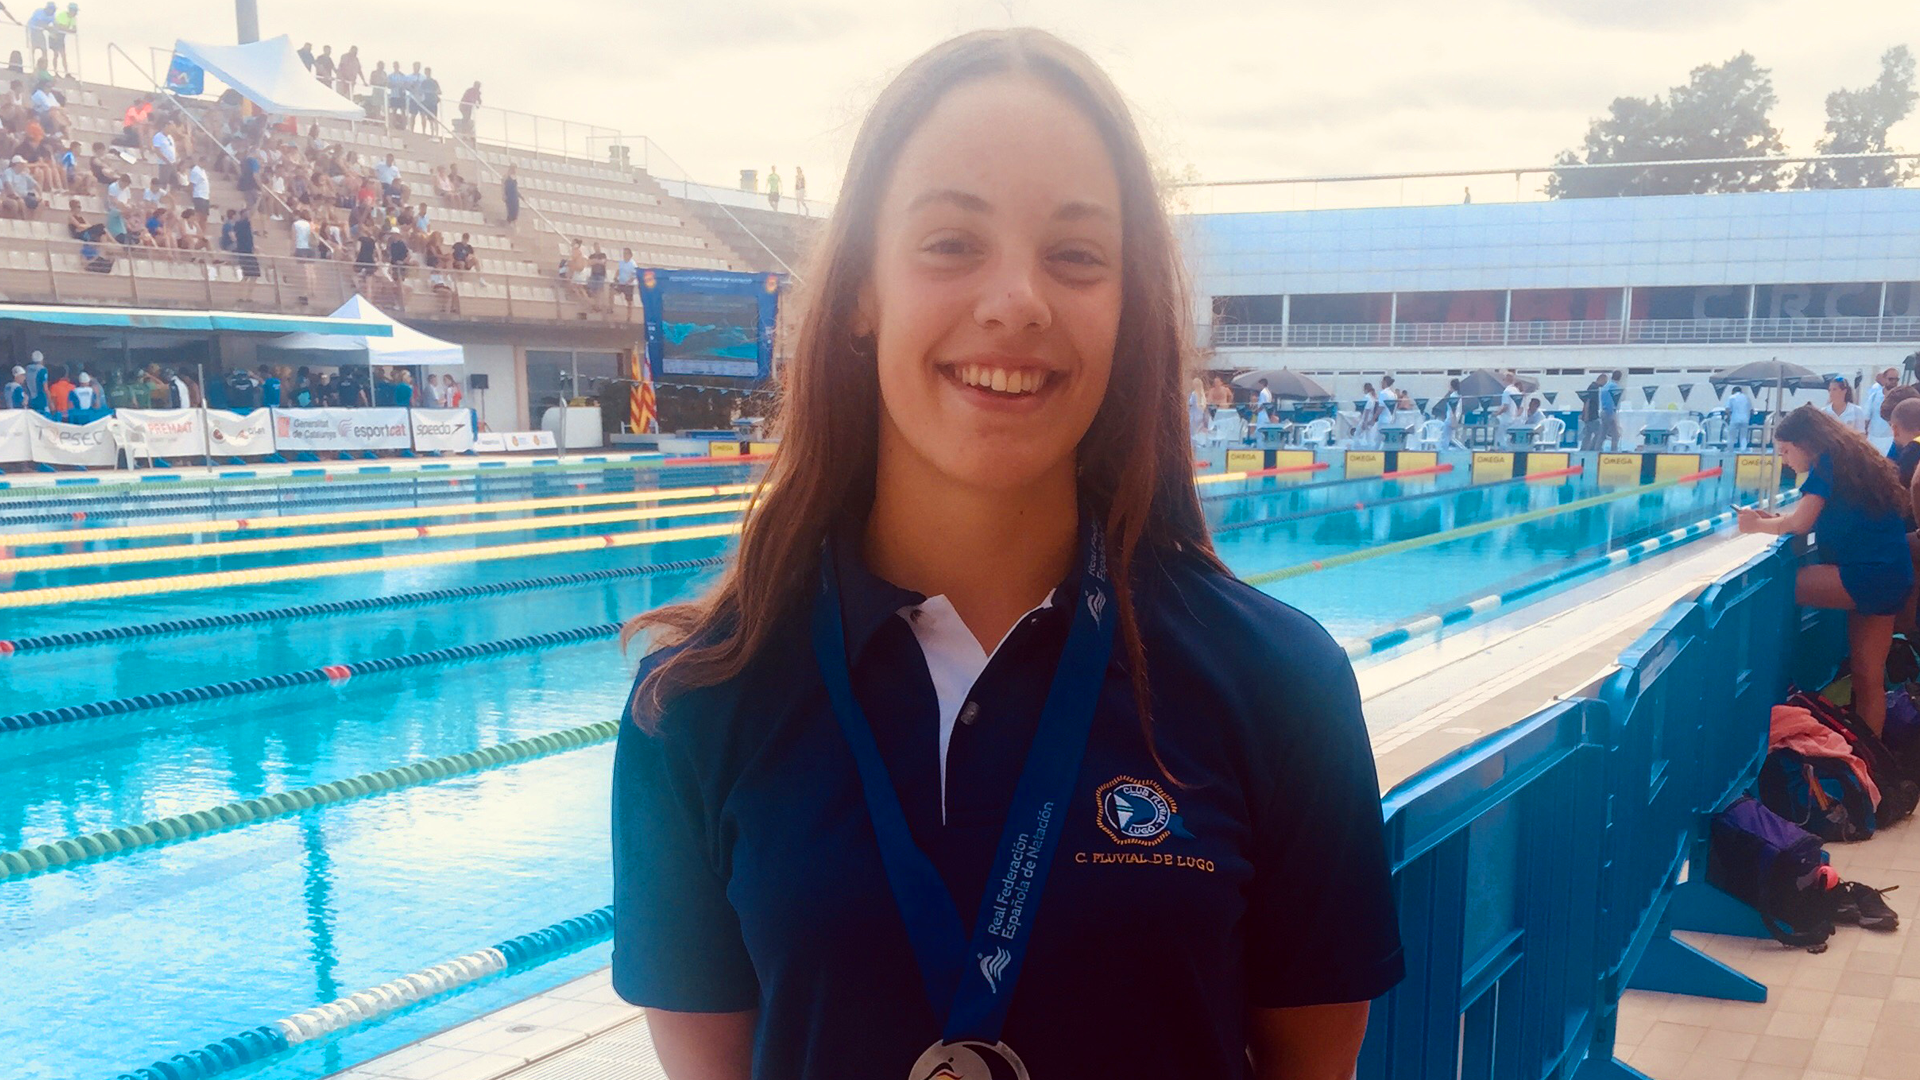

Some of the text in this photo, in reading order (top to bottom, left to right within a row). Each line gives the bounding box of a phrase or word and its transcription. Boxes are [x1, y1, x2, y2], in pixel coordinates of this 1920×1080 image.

[294, 419, 328, 428] Generalitat
[416, 422, 450, 436] speedo
[293, 430, 302, 438] de
[354, 424, 406, 440] esportcat
[1231, 453, 1257, 461] OMEGA
[1350, 454, 1376, 463] OMEGA
[1123, 786, 1149, 797] CLUB
[1150, 795, 1168, 825] FLUVIAL
[1128, 825, 1156, 834] LUGO
[1152, 854, 1173, 865] DE
[1177, 855, 1214, 872] LUGO
[1001, 801, 1054, 940] Española de Natación
[988, 833, 1029, 936] Real Federación
